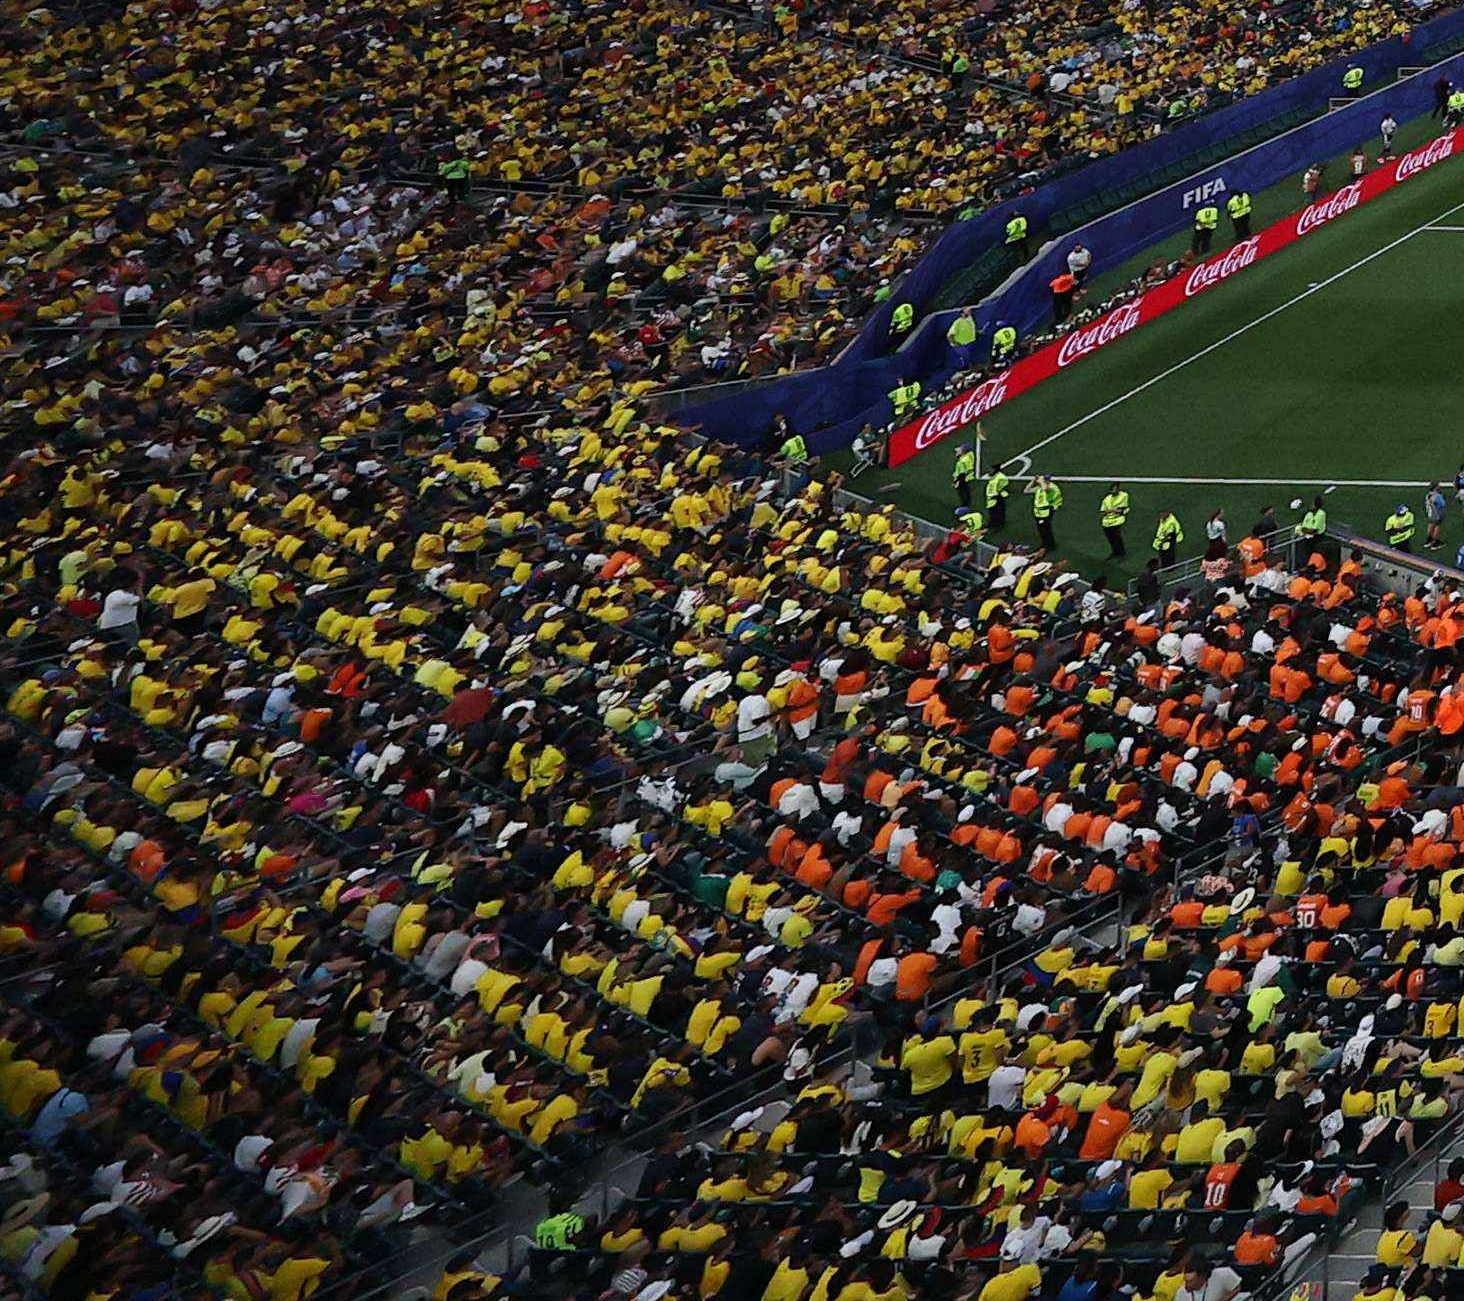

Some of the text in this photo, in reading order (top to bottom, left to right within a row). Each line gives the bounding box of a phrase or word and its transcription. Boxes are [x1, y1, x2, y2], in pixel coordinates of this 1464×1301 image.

[1181, 176, 1227, 211] FIFA
[1297, 909, 1316, 929] 30
[1205, 1182, 1226, 1206] 10
